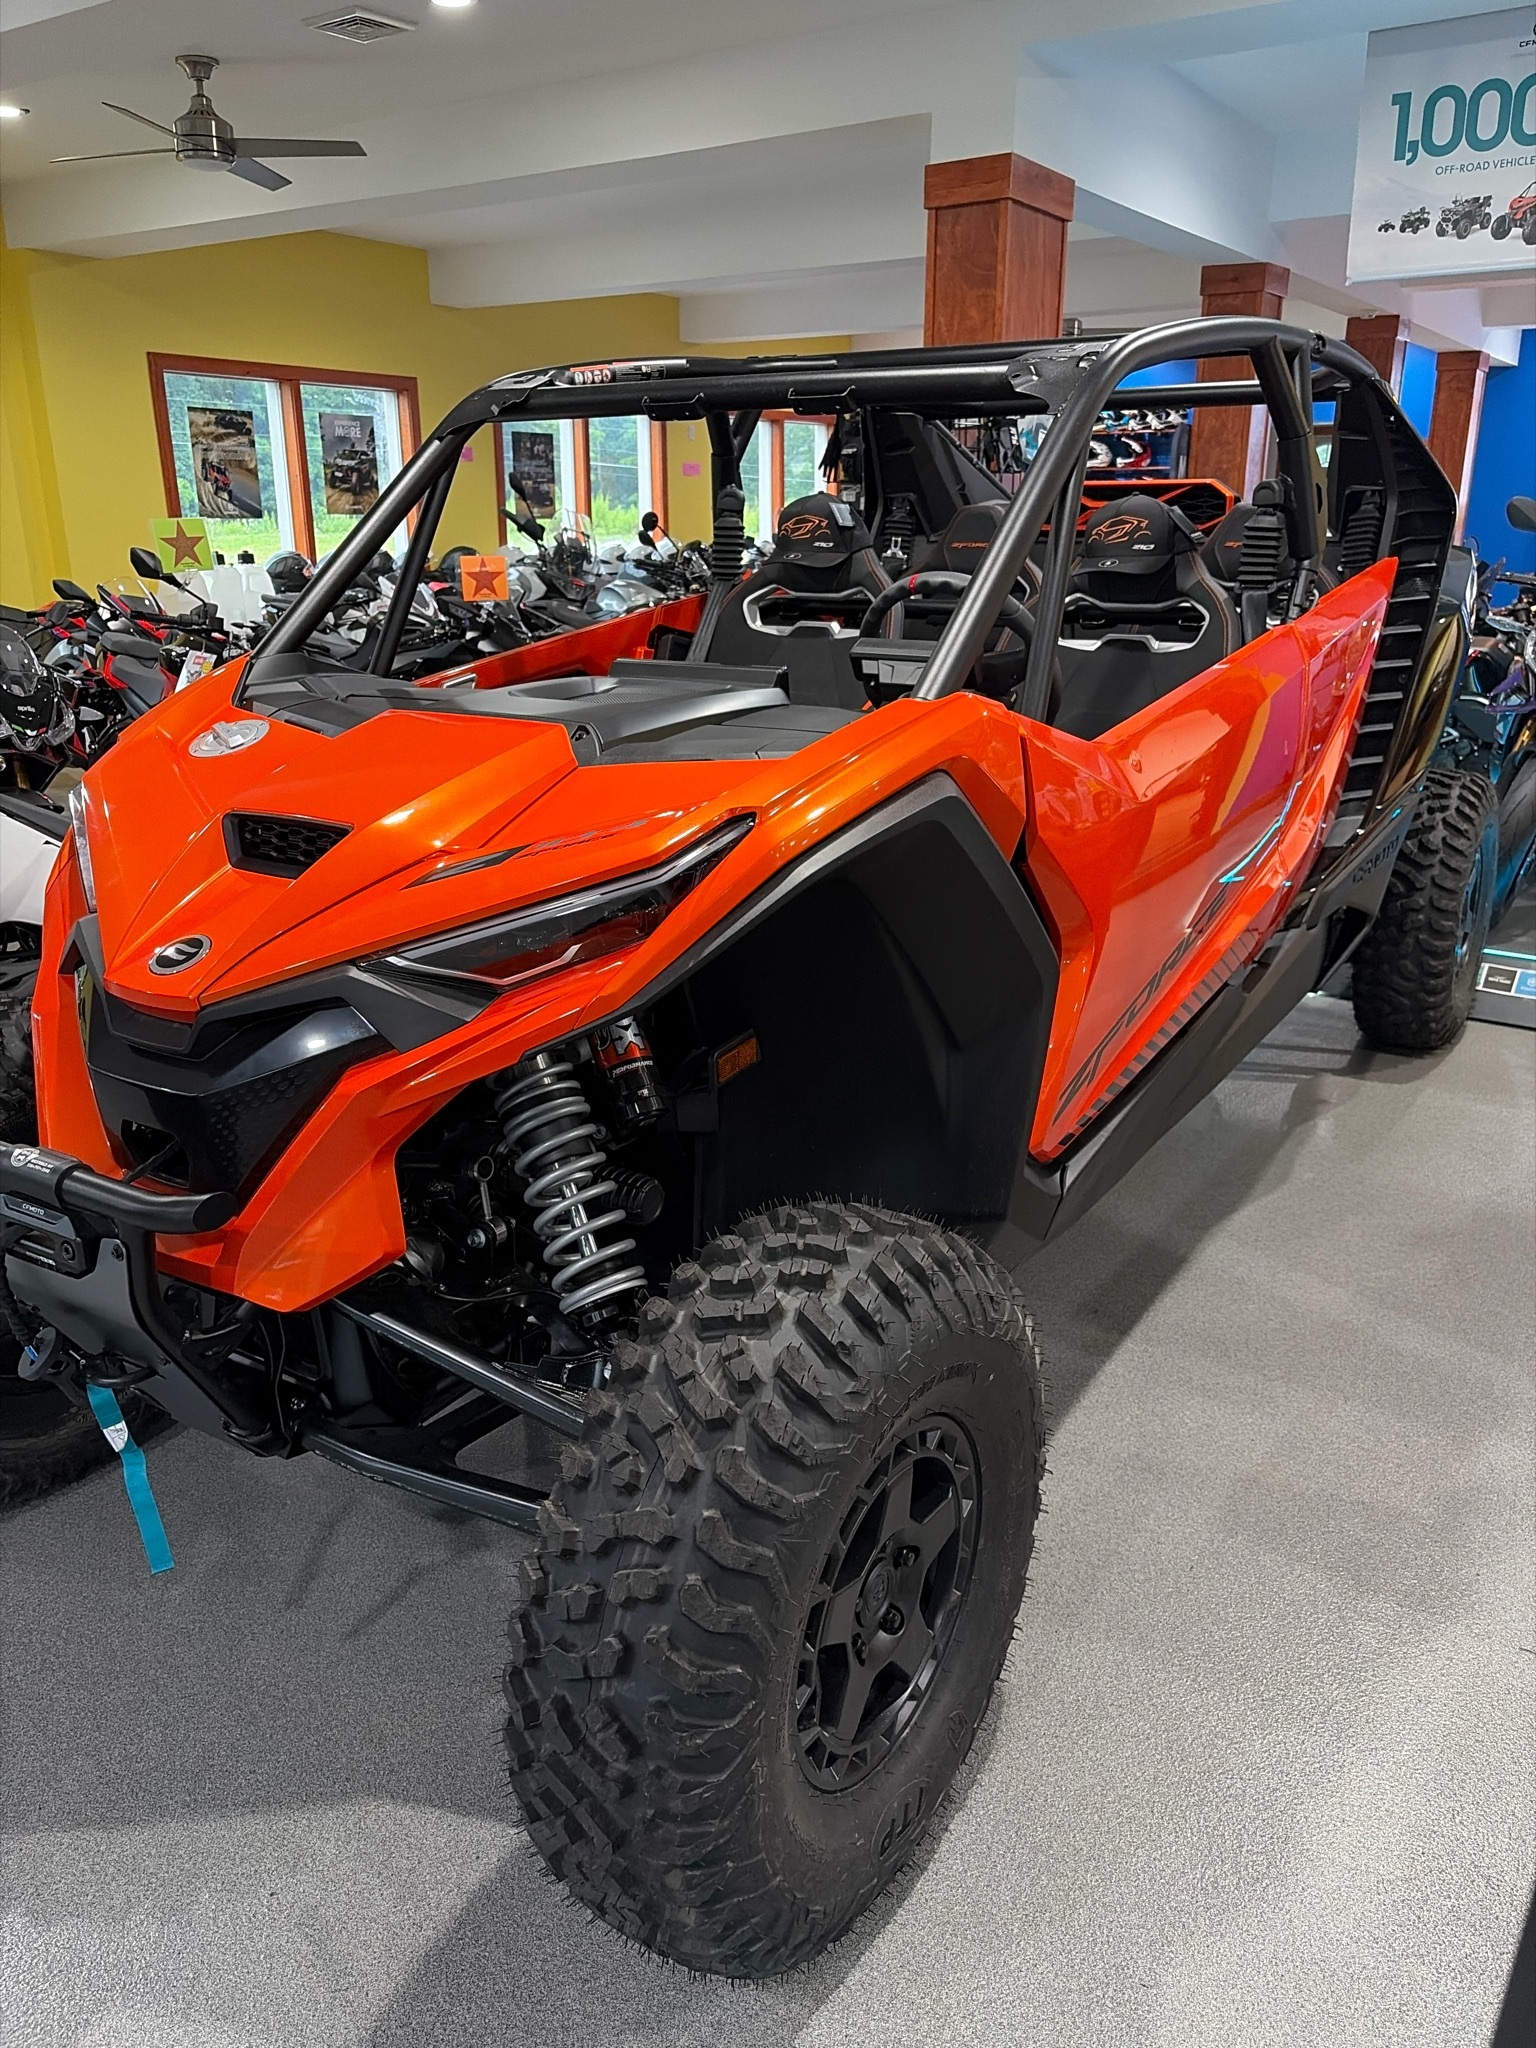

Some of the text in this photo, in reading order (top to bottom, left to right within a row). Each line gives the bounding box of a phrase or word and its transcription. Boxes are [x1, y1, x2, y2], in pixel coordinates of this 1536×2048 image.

[1435, 155, 1536, 176] OFF-ROAD VEHICLE
[335, 426, 361, 438] MORE
[612, 1060, 653, 1078] PERFORMANCE
[22, 1203, 45, 1216] CFMOTO
